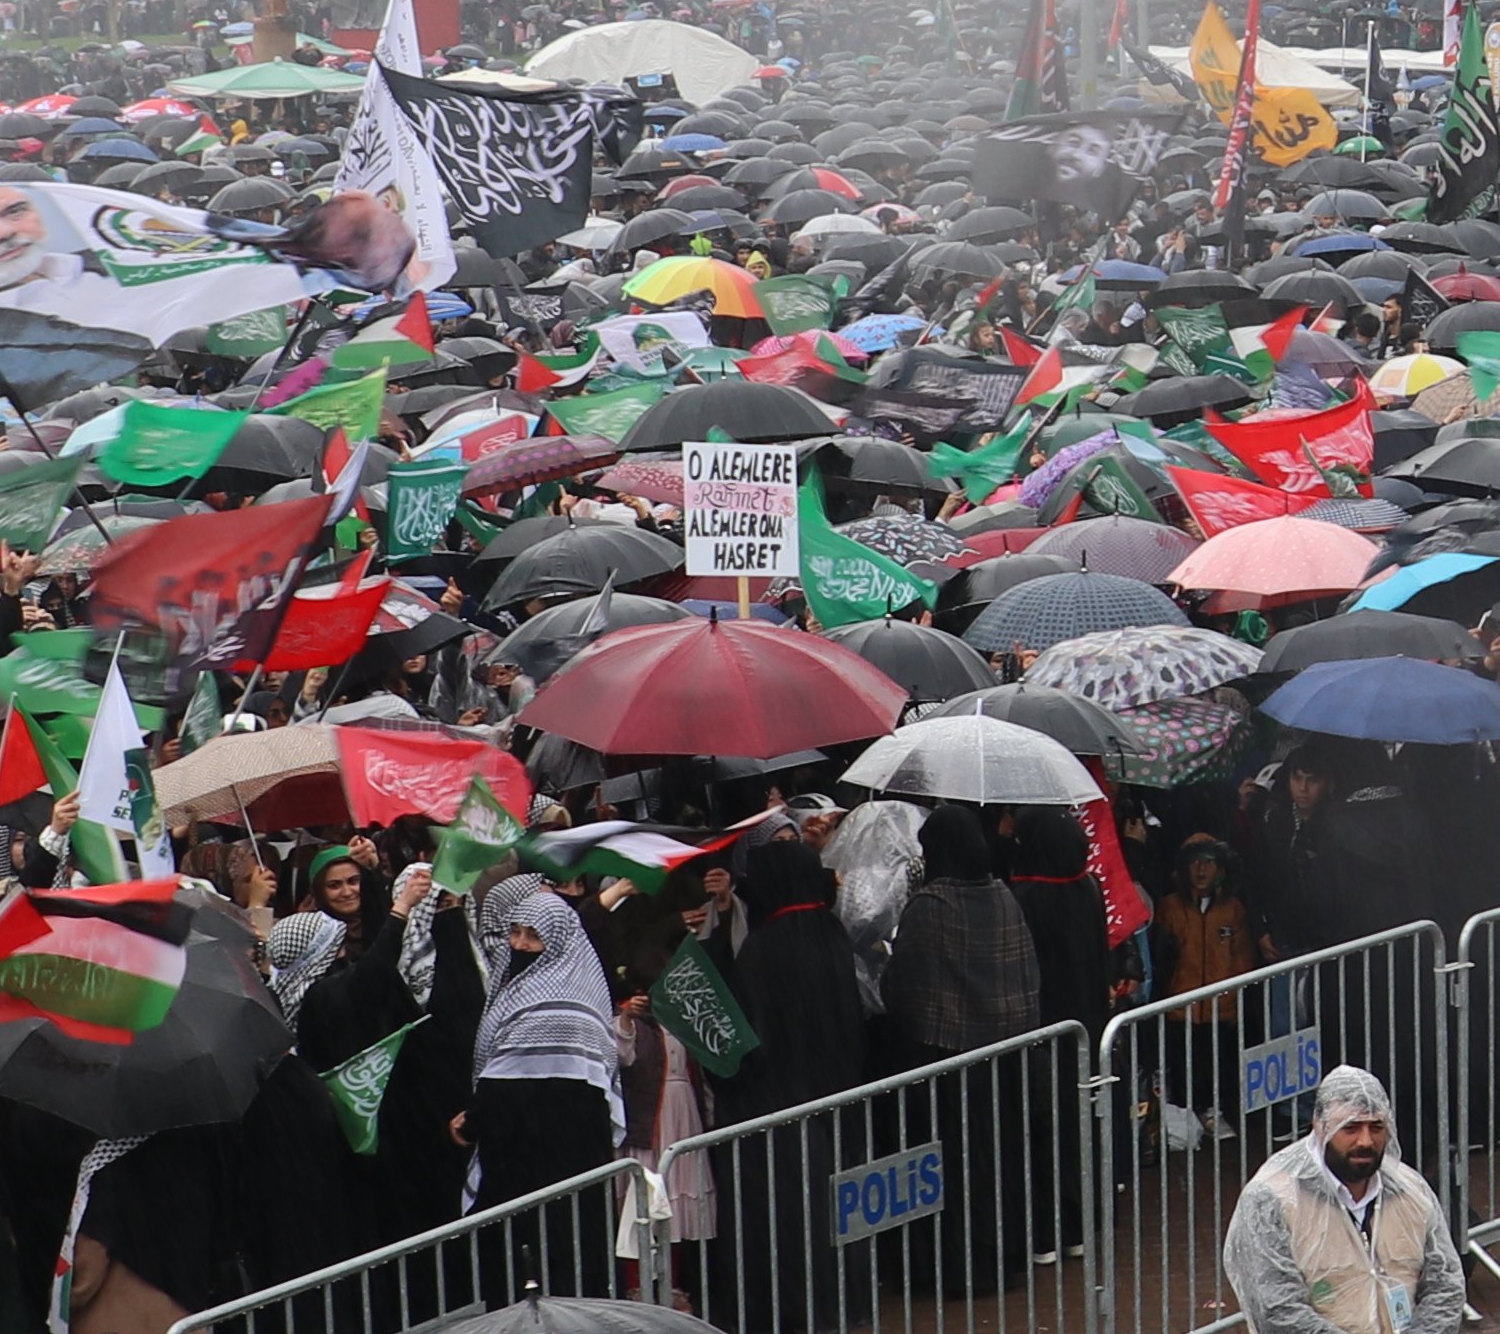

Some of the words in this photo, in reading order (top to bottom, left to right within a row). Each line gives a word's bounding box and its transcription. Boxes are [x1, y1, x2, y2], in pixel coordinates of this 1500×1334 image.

[689, 449, 702, 481] O
[709, 450, 792, 484] ALEMLERE
[694, 482, 777, 512] Rahmet
[688, 509, 758, 538] ALEMLER
[714, 542, 782, 571] HASRET
[1246, 1031, 1321, 1111] POLİS
[838, 1151, 942, 1235] POLİS
